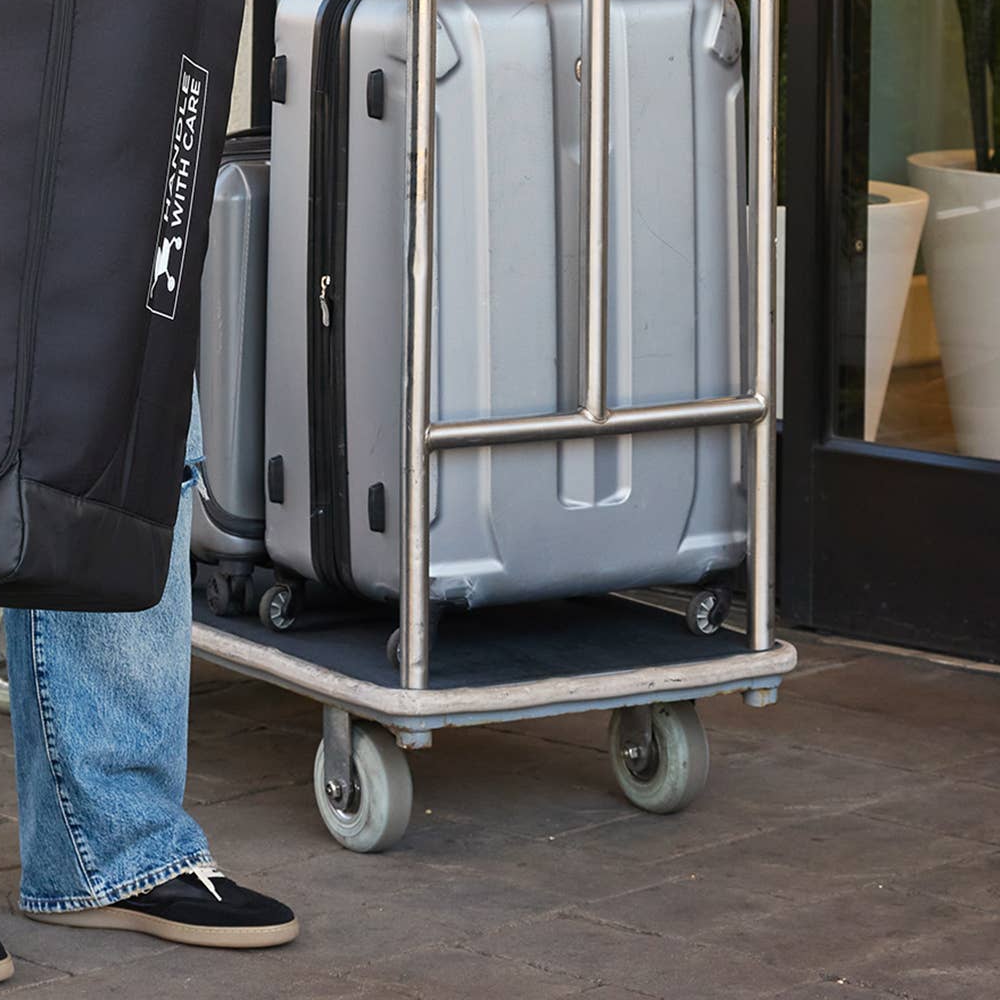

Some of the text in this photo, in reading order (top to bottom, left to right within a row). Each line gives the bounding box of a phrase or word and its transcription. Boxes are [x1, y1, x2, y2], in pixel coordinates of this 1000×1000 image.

[164, 71, 190, 222] HANDLE
[171, 79, 201, 227] WITH CARE
